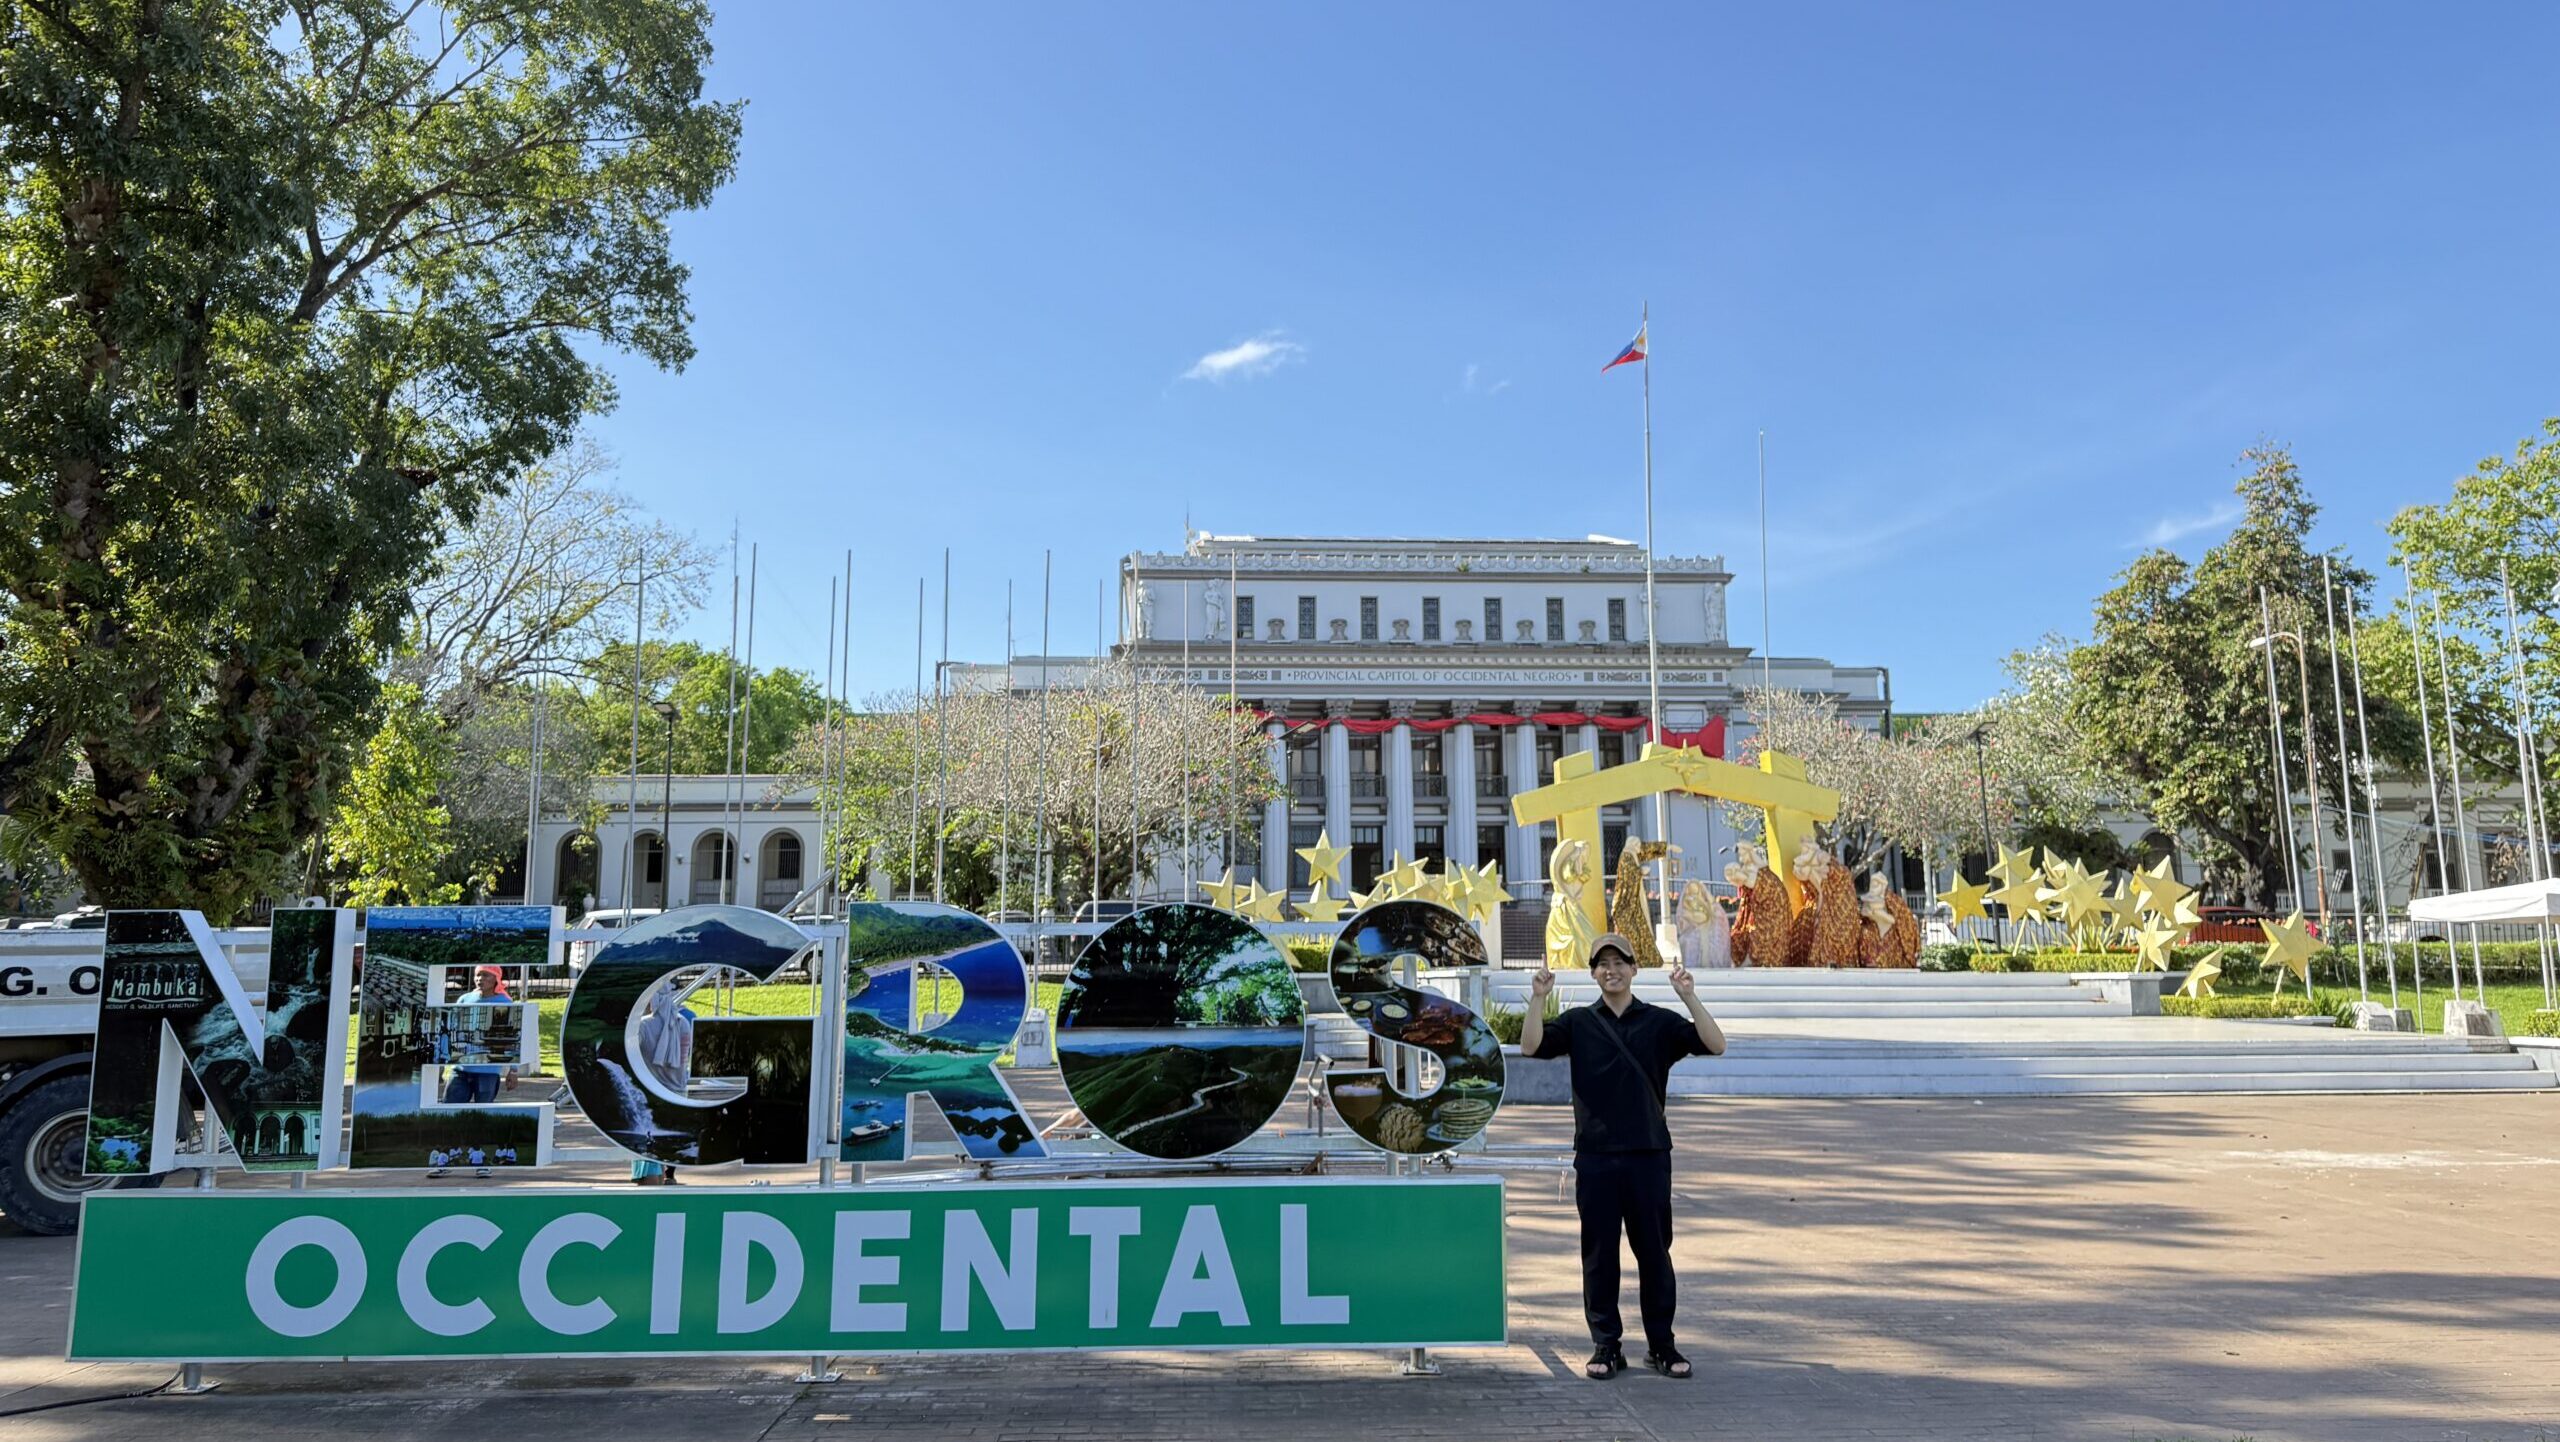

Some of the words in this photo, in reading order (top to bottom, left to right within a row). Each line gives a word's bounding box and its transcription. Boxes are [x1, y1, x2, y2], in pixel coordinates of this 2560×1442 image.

[1293, 670, 1365, 681] PROVINCIAL
[1367, 670, 1418, 681] CAPITOL
[1422, 670, 1440, 681] OF
[1443, 671, 1519, 681] OCCIDENTAL
[1523, 671, 1572, 682] NEGROS
[0, 966, 47, 996] G.
[111, 977, 204, 998] Mambukal
[83, 900, 1507, 1176] NEGROS
[245, 1203, 1350, 1337] OCCIDENTAL
